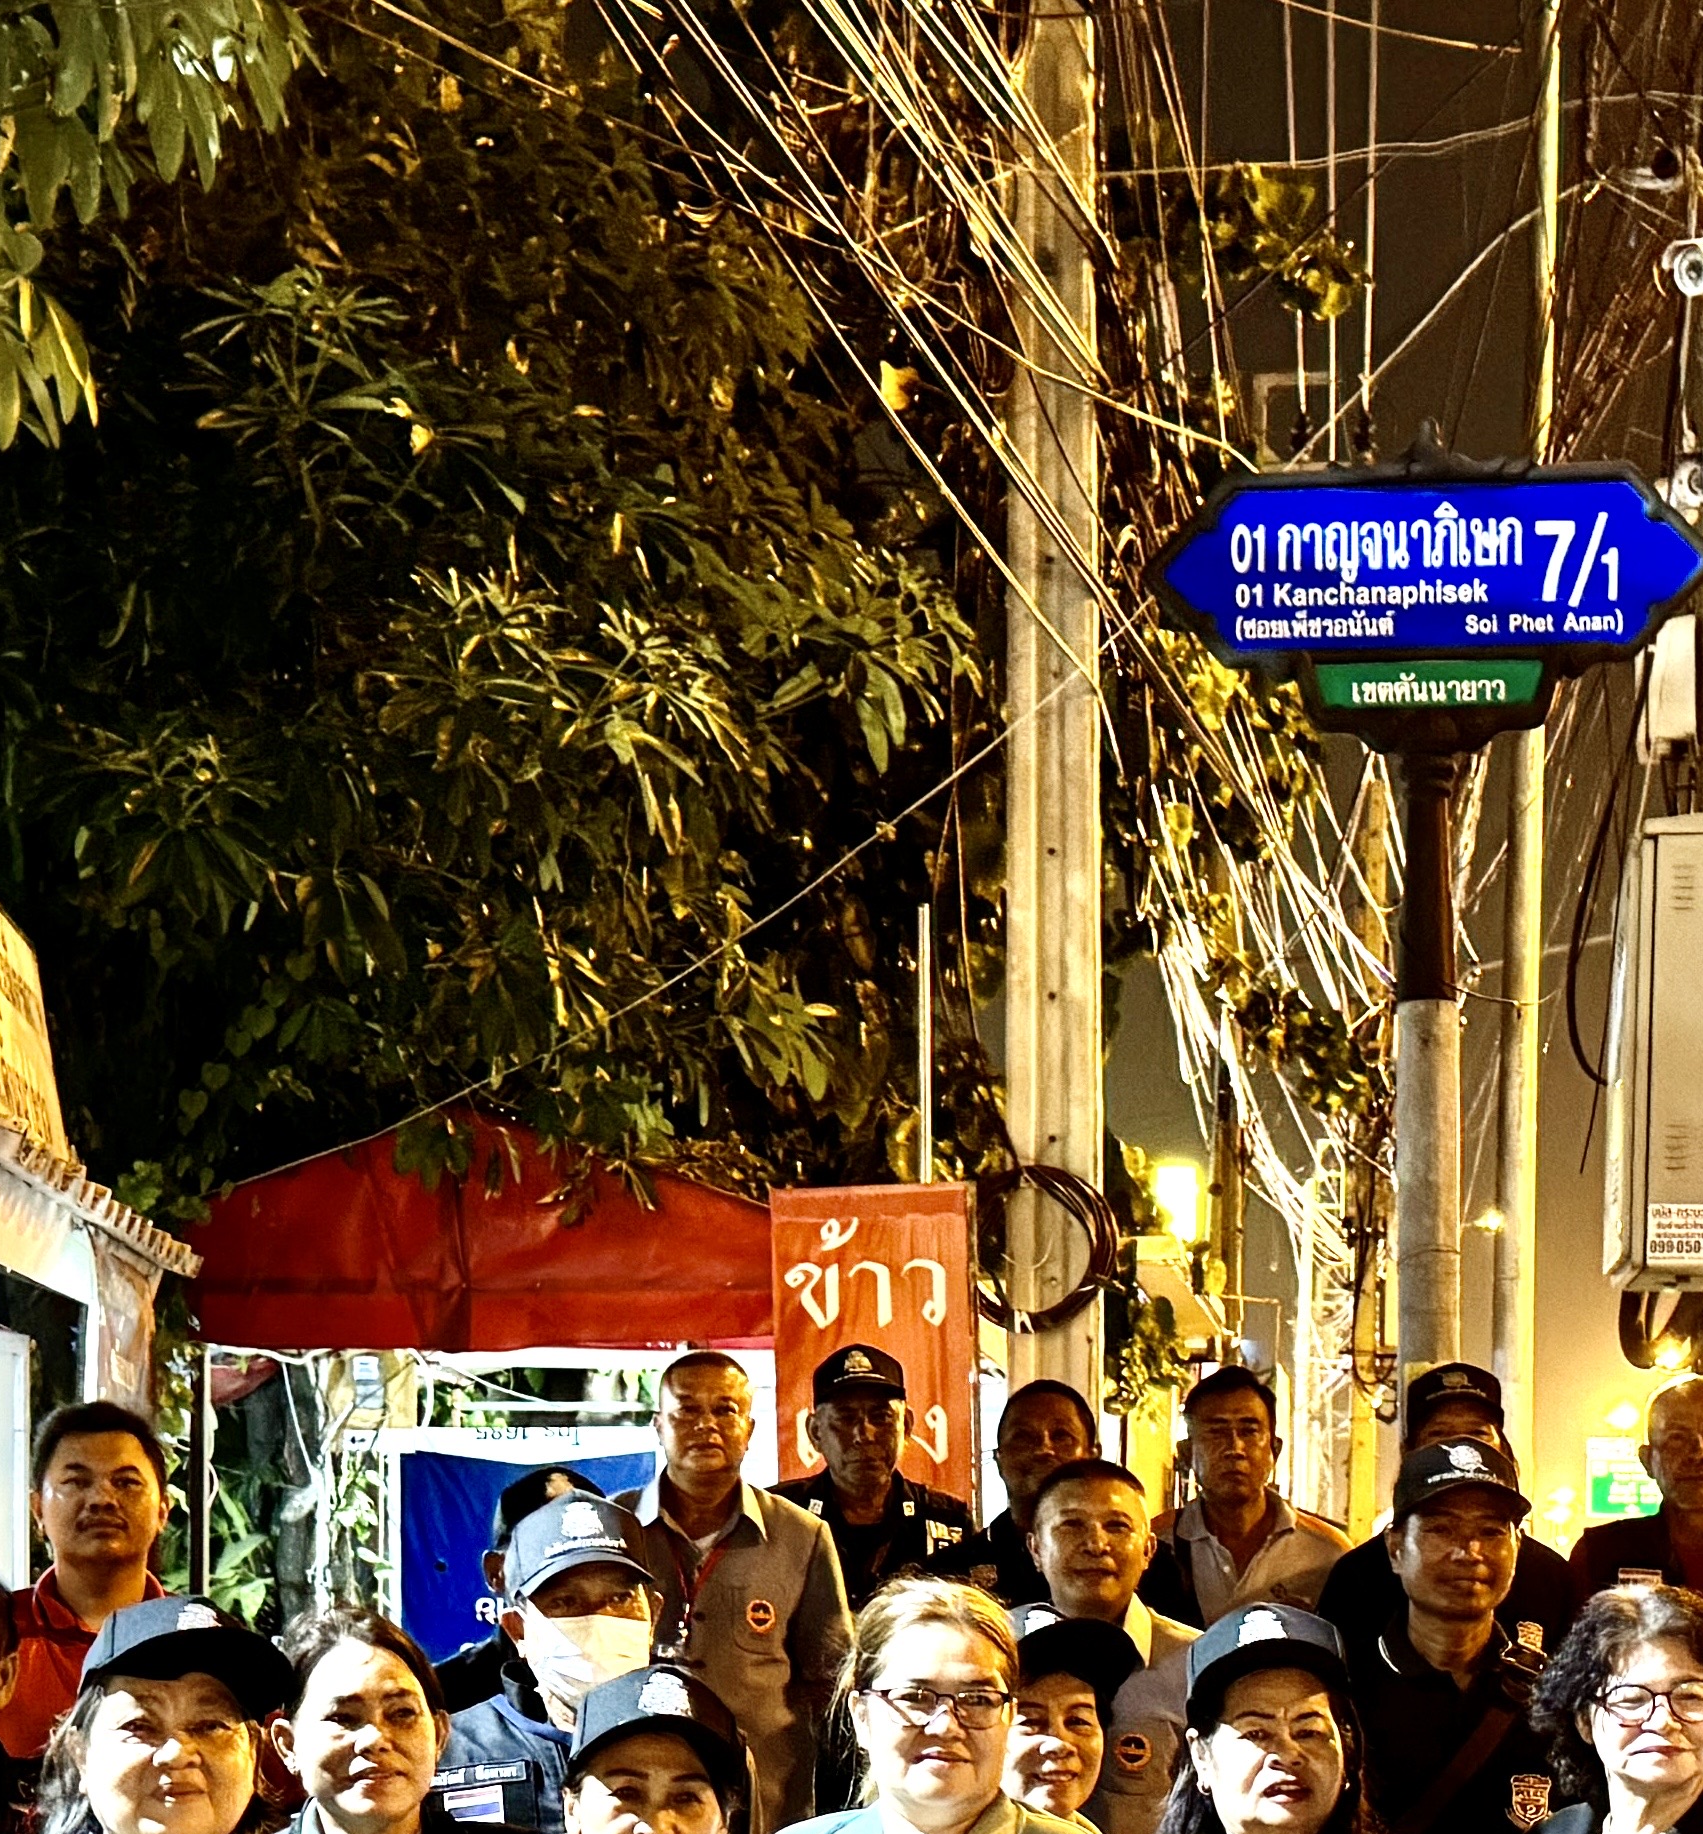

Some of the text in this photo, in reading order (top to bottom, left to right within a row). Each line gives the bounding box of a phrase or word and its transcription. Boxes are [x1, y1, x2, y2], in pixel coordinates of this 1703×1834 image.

[1229, 500, 1621, 608] 01 กาญจนาภิเษก 7/1
[1234, 578, 1490, 611] 01 Kanchanaphisek
[1464, 613, 1500, 636] Soi
[1508, 612, 1554, 635] Phet
[1563, 611, 1625, 637] Anan)
[1351, 674, 1507, 707] เขตคันนายาว
[784, 1216, 950, 1330] ข้าว
